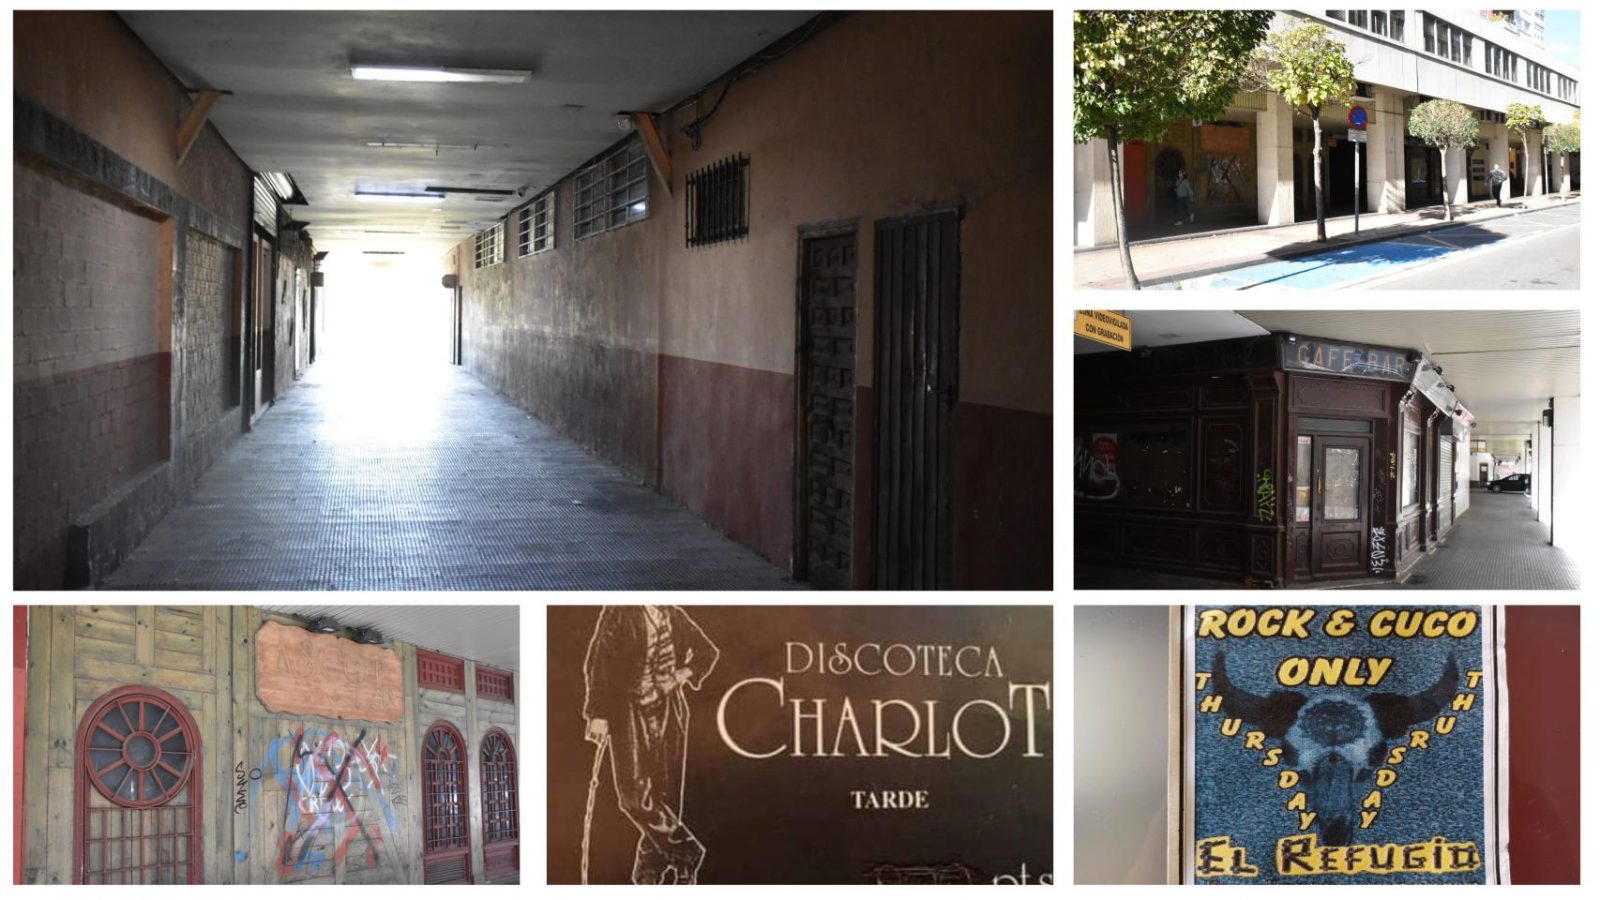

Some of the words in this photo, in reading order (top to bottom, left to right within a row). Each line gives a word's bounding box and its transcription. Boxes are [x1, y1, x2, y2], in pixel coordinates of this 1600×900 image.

[1085, 323, 1097, 334] CON
[1367, 351, 1406, 376] BAR
[1197, 609, 1315, 640] ROCK
[1323, 610, 1357, 638] &
[1369, 608, 1478, 639] CUCO
[786, 642, 1003, 678] DISCOTECA
[1276, 656, 1392, 687] ONLY
[716, 677, 1051, 759] CHARLOT
[1195, 672, 1318, 831] THURSDAY
[1359, 670, 1483, 830] THURSDAY
[851, 790, 930, 811] TARDE
